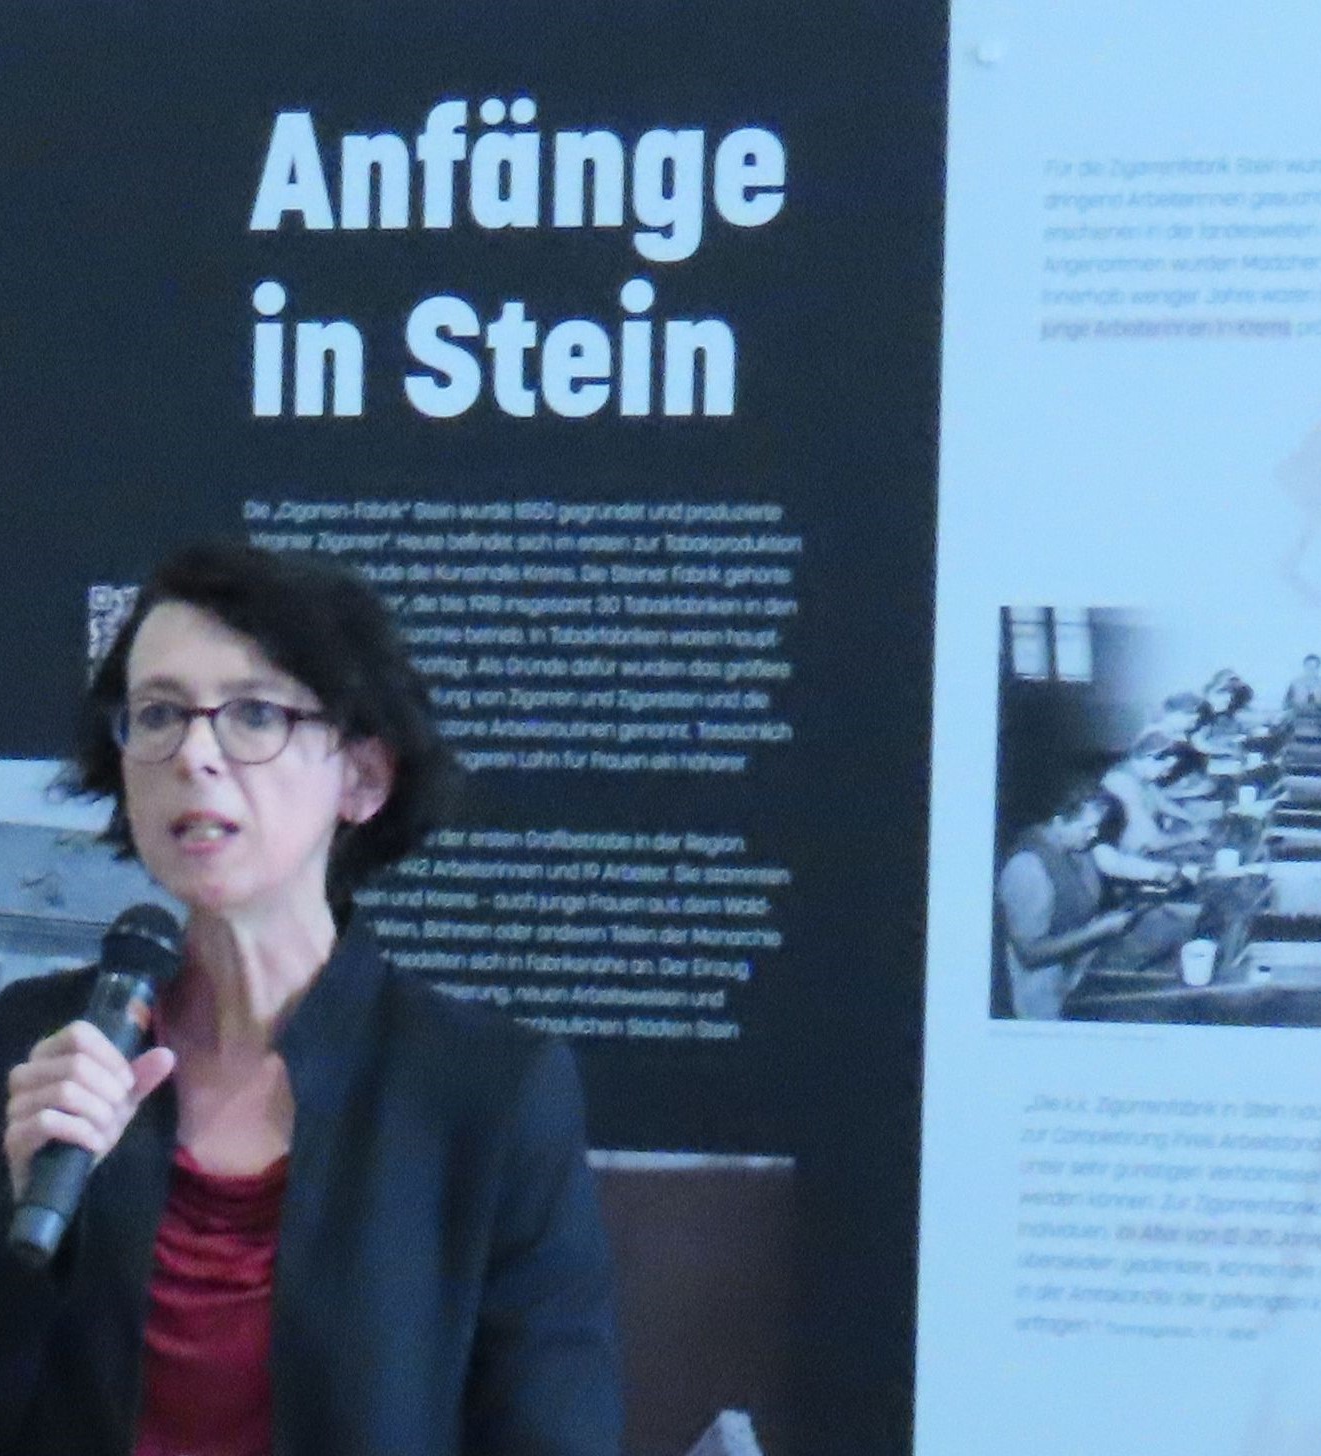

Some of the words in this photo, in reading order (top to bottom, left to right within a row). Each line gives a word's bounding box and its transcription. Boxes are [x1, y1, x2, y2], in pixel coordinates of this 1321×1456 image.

[248, 97, 787, 263] Anfänge
[252, 280, 364, 417] in
[404, 277, 737, 418] Stein
[414, 502, 456, 519] Stein
[459, 502, 512, 519] wurde
[515, 502, 554, 520] 1850
[558, 502, 645, 524] gegründet
[649, 503, 682, 520] und
[686, 502, 783, 522] produzierte
[447, 532, 512, 550] befindet
[517, 534, 552, 551] sich
[578, 535, 631, 551] ersten
[634, 536, 659, 552] zur
[666, 534, 803, 553] Tabakproduktion
